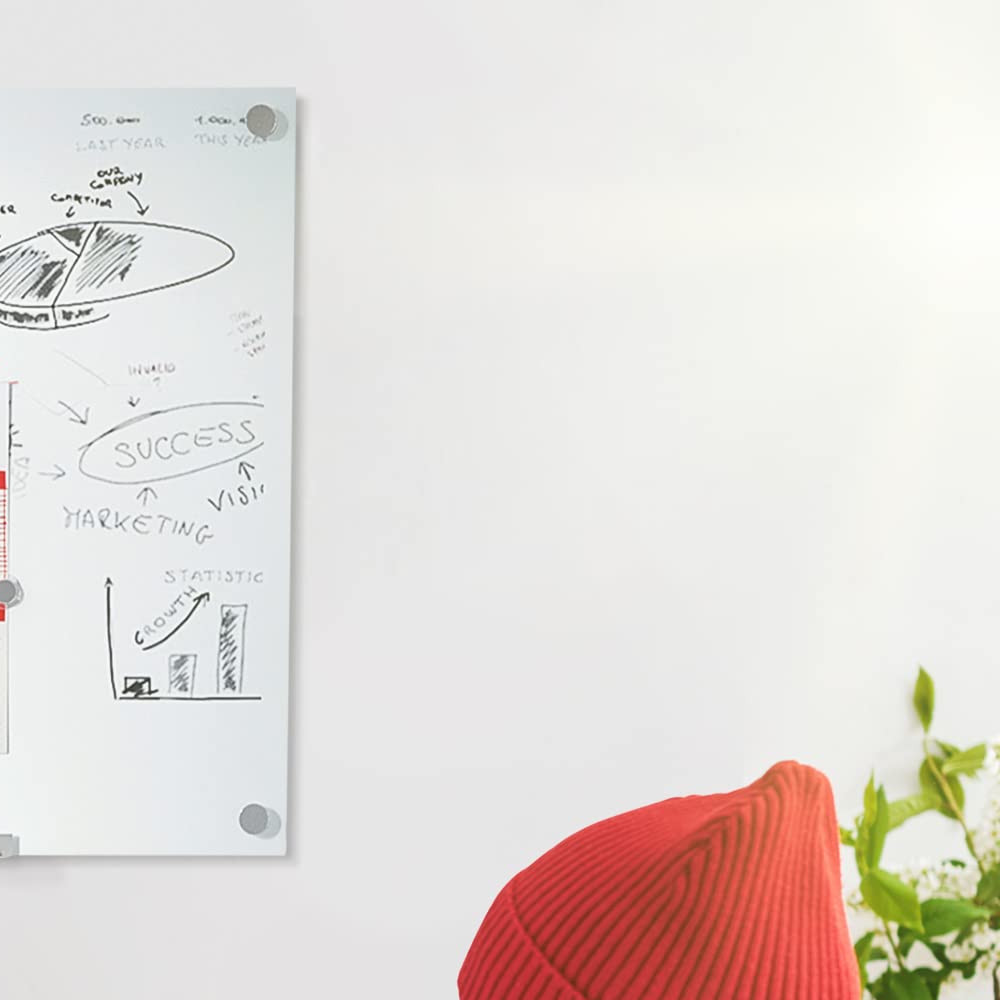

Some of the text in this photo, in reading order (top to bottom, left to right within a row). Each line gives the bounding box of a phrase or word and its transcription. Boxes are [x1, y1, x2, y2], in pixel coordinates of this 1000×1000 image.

[122, 137, 167, 150] YEAR
[194, 134, 228, 146] THIS
[114, 420, 256, 468] SUCCESS
[207, 484, 265, 512] VISI
[63, 505, 215, 544] MARKETING
[164, 568, 265, 584] STATISTIC
